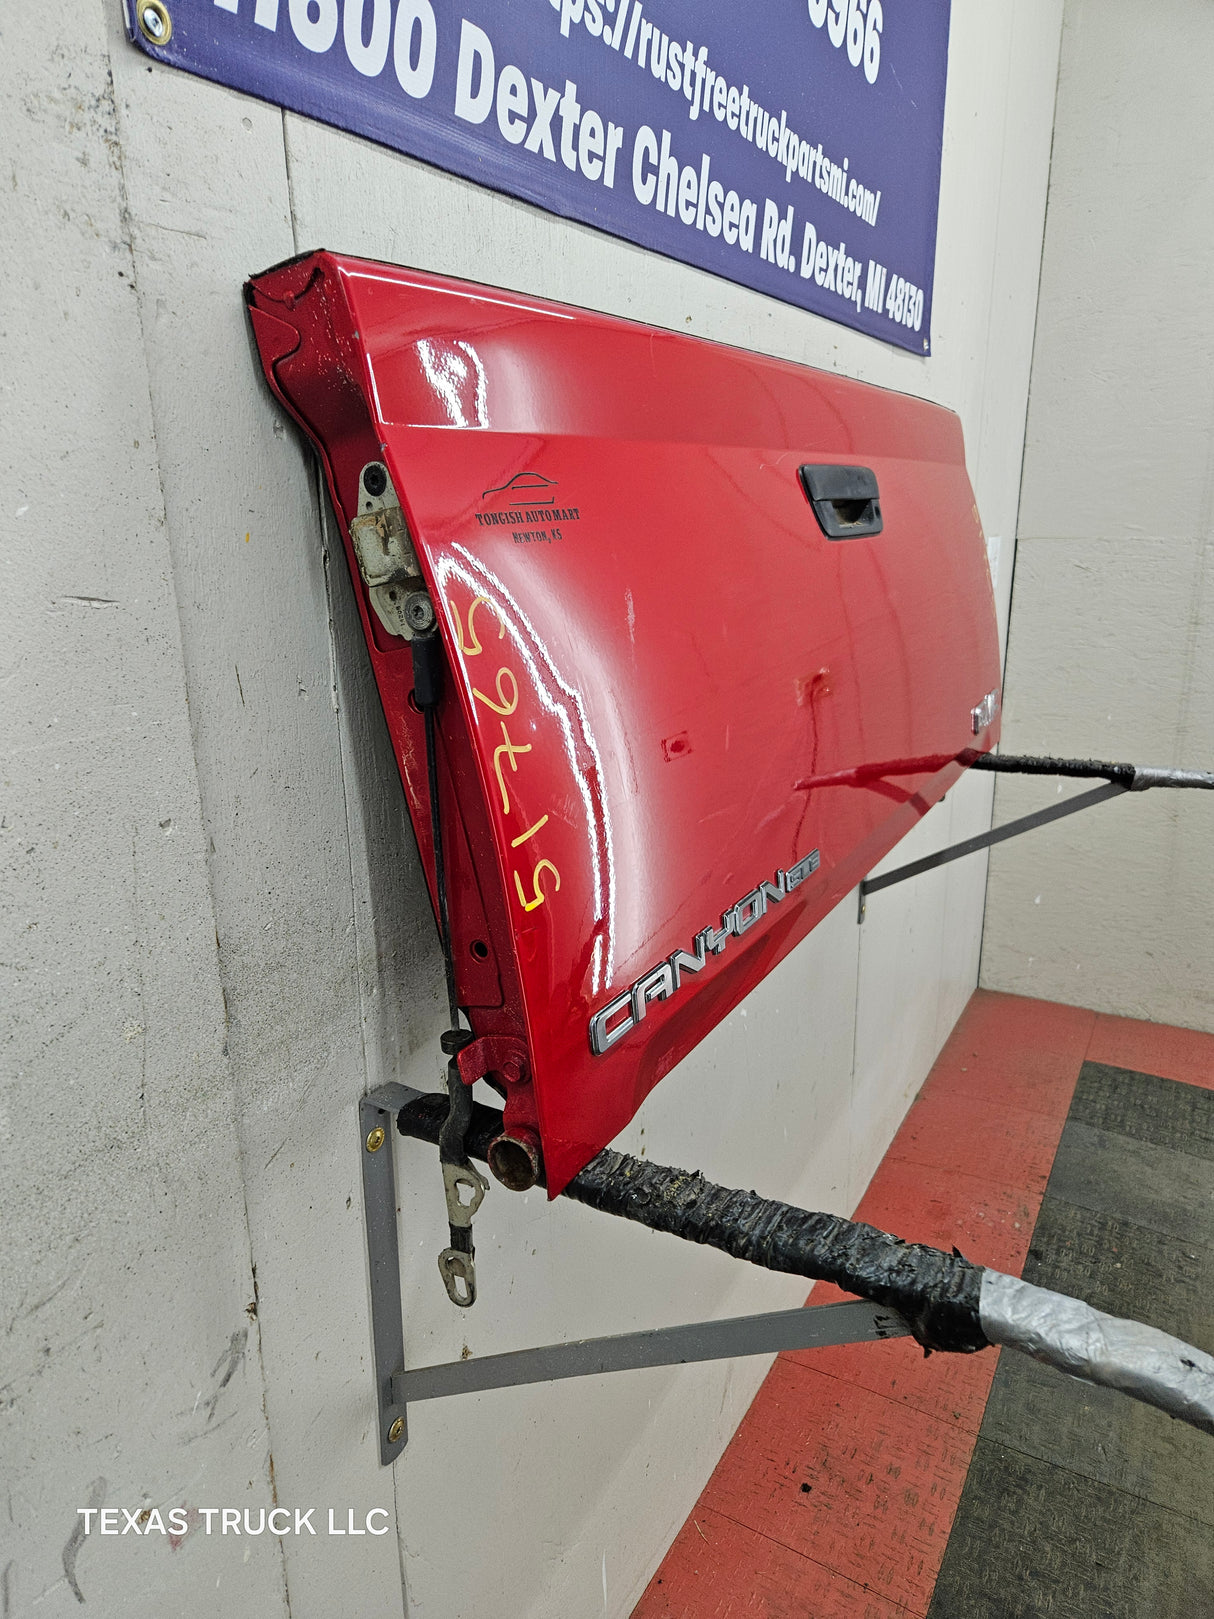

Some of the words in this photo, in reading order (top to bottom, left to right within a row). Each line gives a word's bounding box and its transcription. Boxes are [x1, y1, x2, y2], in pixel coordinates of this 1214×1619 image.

[455, 18, 623, 188] Dexter
[633, 126, 757, 253] Chelsea
[760, 198, 795, 272] Rd.
[800, 222, 862, 312] Dexter,
[865, 260, 887, 313] MI
[886, 274, 923, 331] 48130
[549, 0, 881, 226] ps://rustfreetruckpartsmi.com/
[475, 510, 524, 526] TONGISH
[512, 530, 551, 544] NEWTON,
[550, 528, 563, 540] KS
[589, 868, 785, 1057] CANYON
